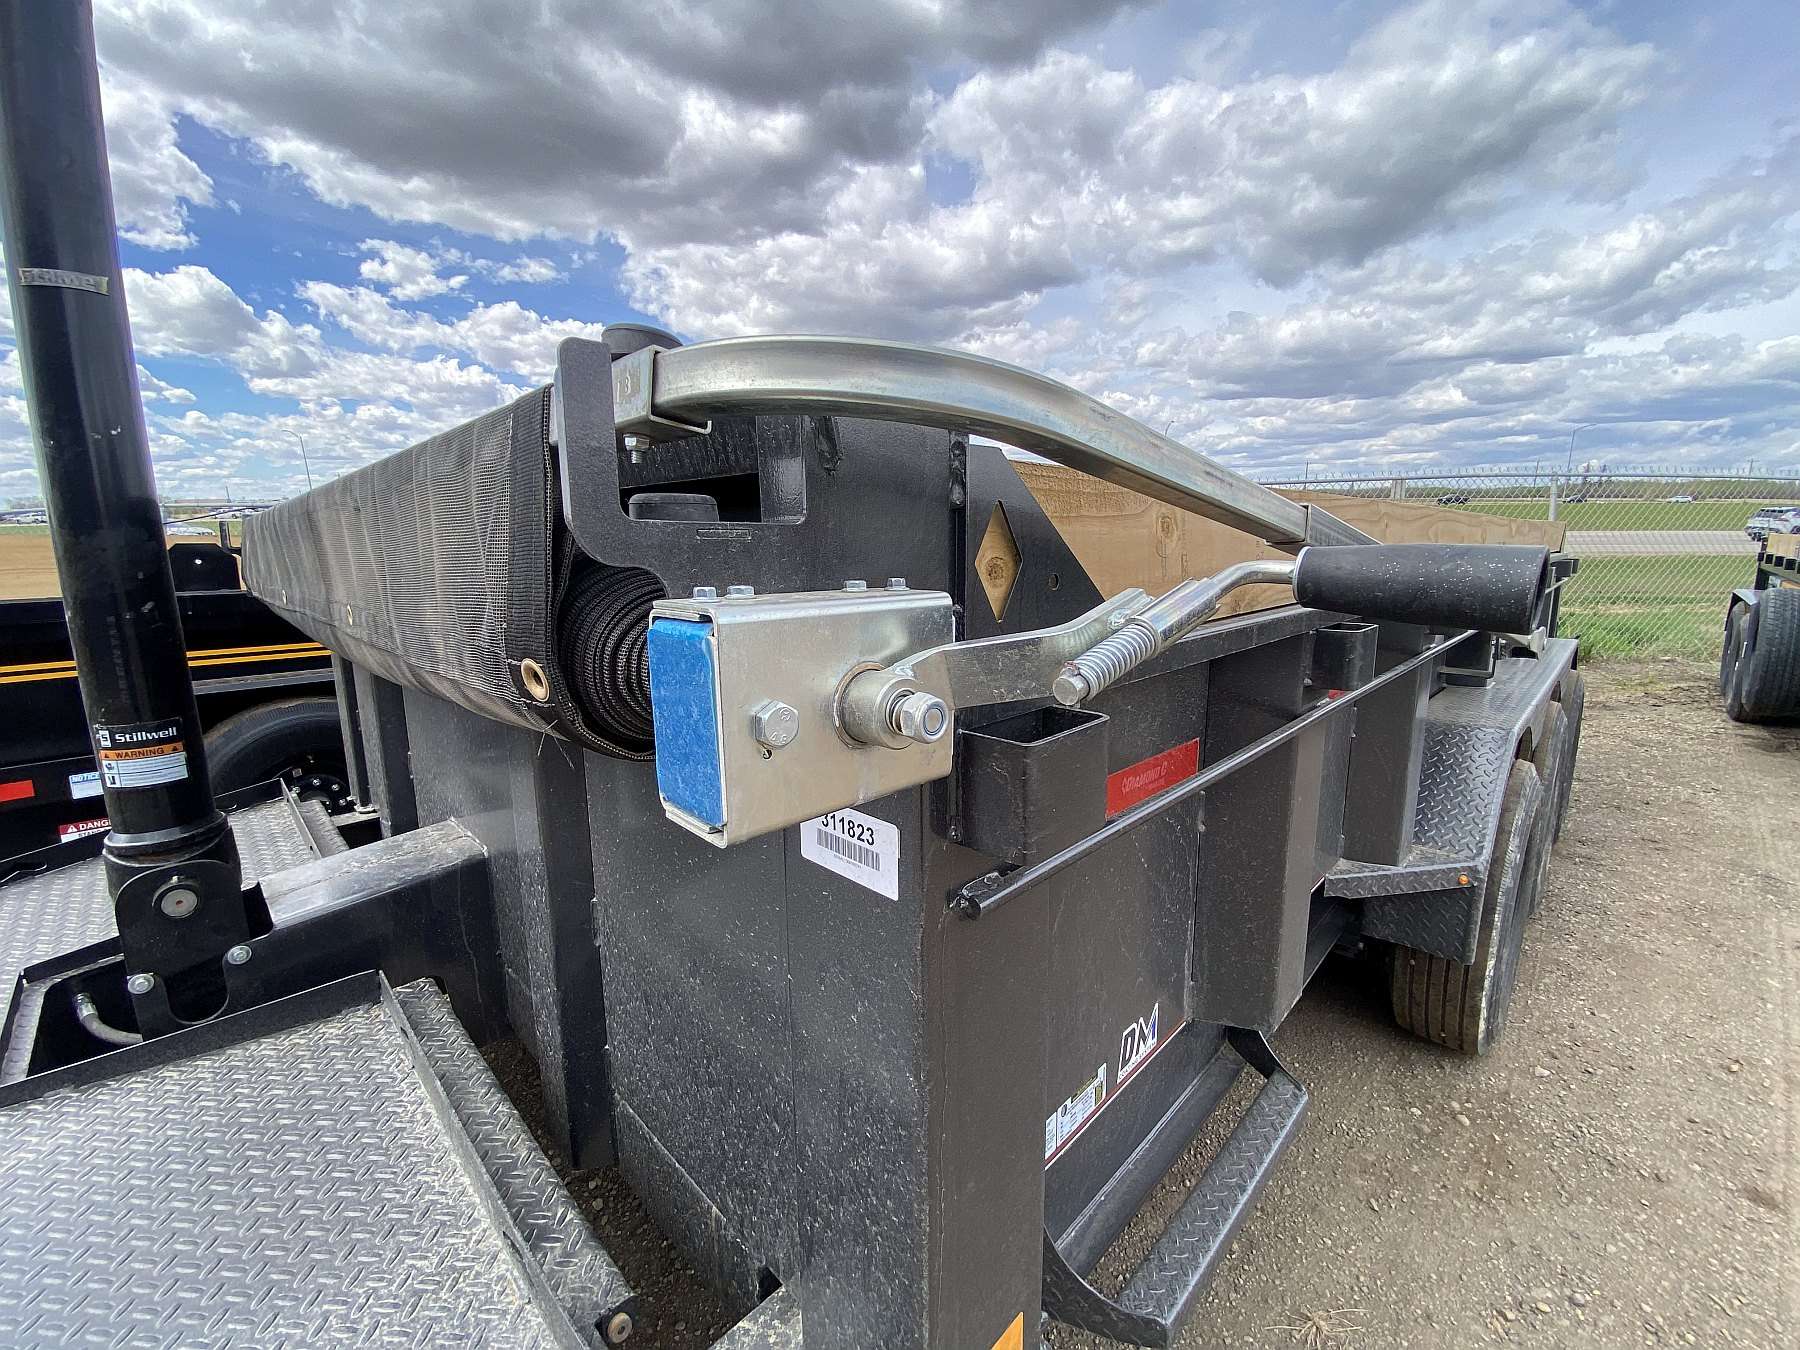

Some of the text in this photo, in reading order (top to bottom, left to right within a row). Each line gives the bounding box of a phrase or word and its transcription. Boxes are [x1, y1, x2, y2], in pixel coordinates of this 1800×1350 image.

[115, 727, 177, 743] Stillwell
[115, 747, 165, 759] WARNING
[1125, 766, 1160, 792] DIAMOND
[80, 820, 112, 831] DANG
[821, 813, 875, 846] 311823
[1119, 1003, 1158, 1071] DM
